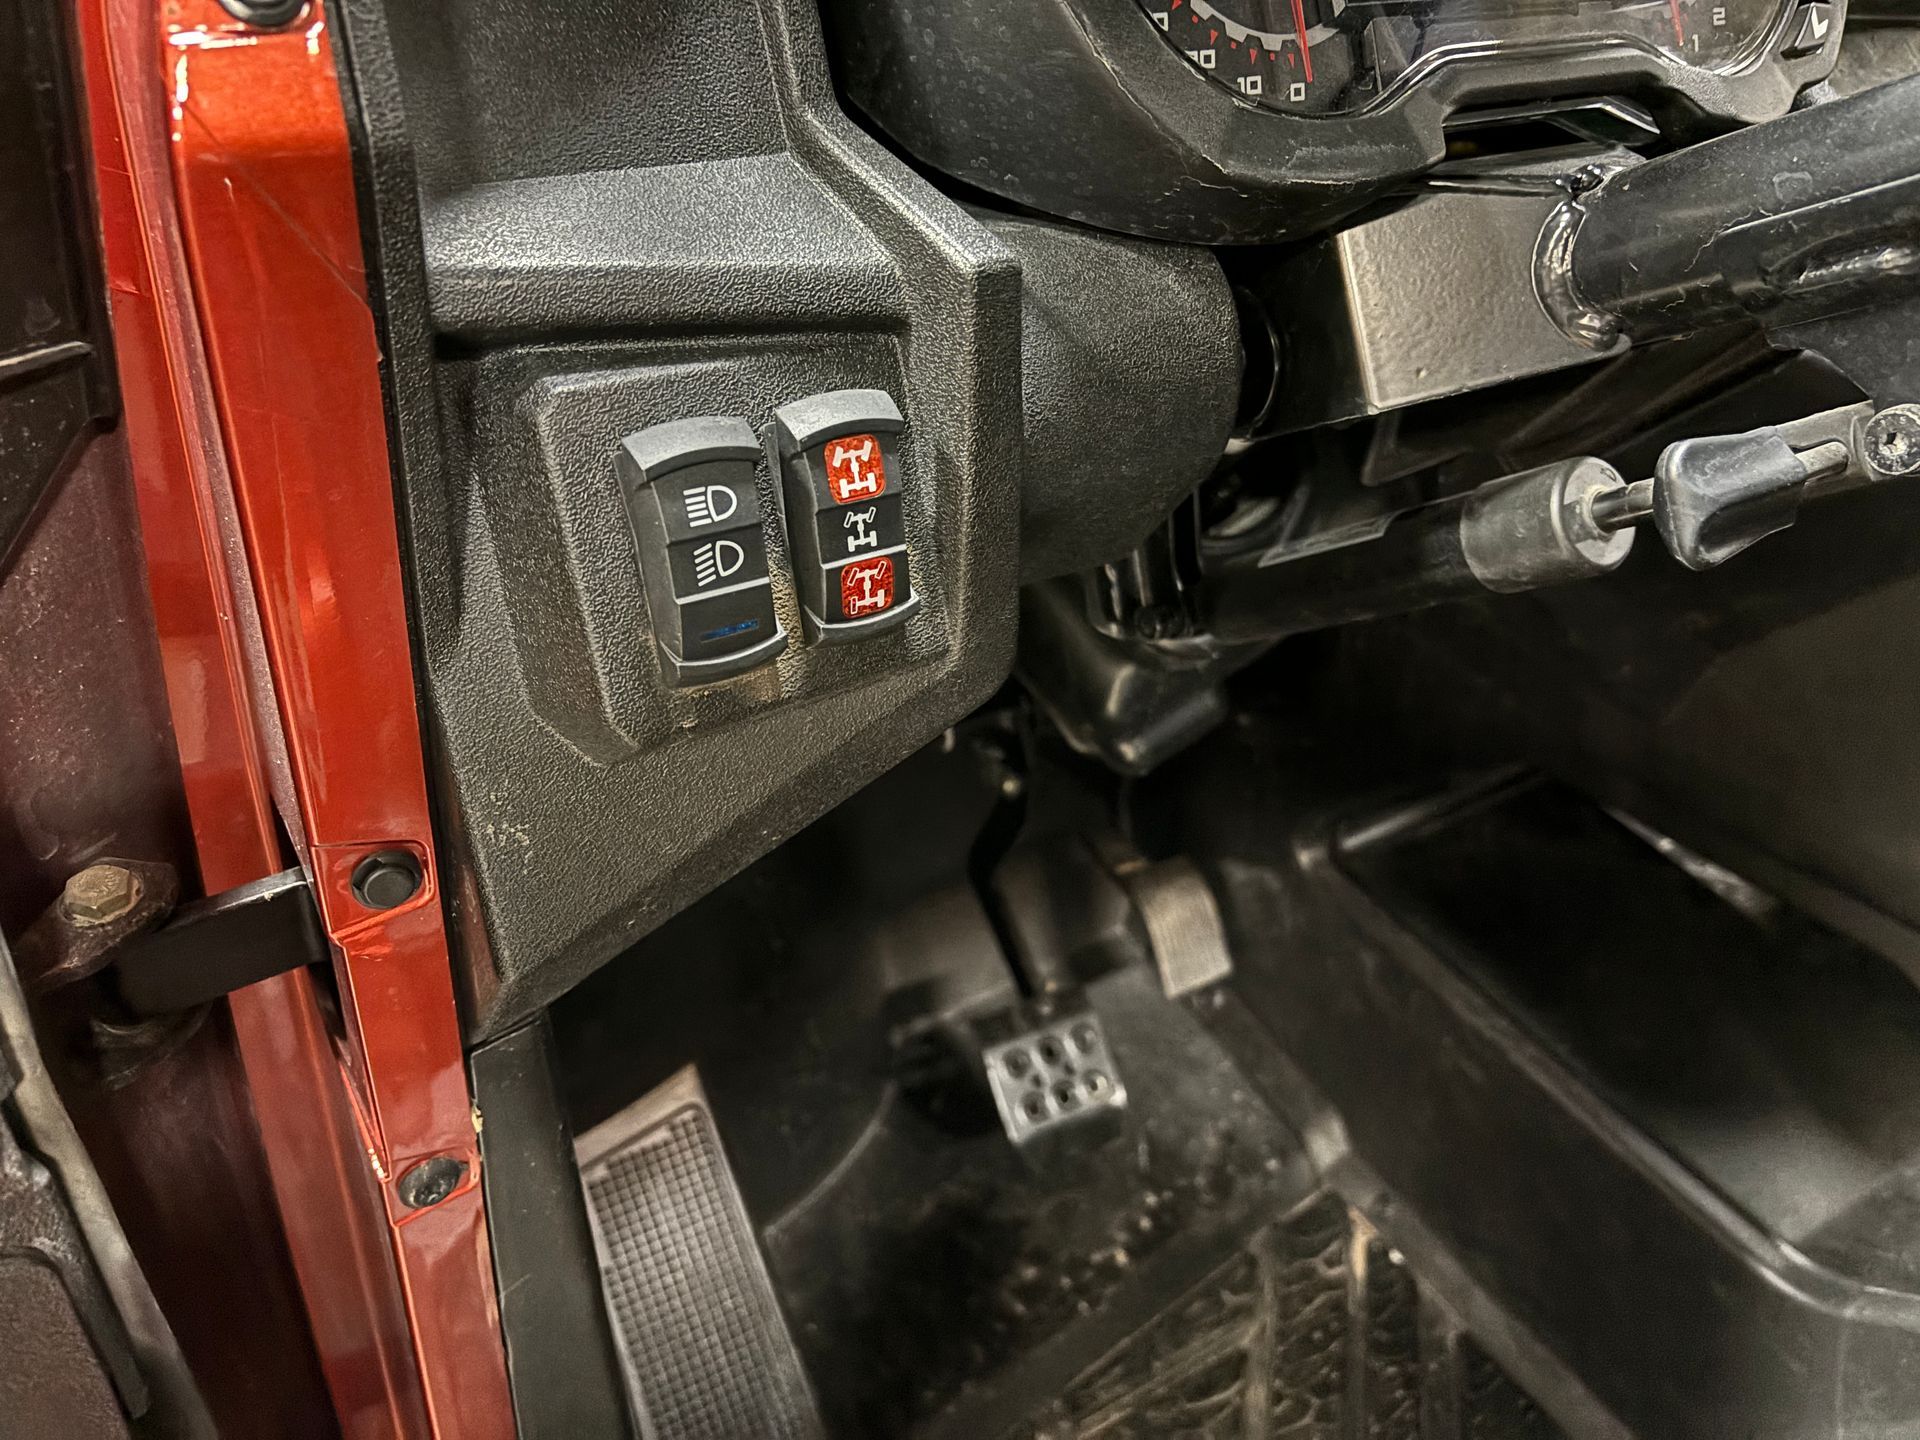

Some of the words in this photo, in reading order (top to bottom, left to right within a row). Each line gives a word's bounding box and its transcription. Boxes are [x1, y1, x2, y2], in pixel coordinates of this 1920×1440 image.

[1712, 7, 1726, 26] 2
[1691, 34, 1699, 53] 1
[1236, 75, 1262, 95] 10
[1290, 82, 1305, 102] 0
